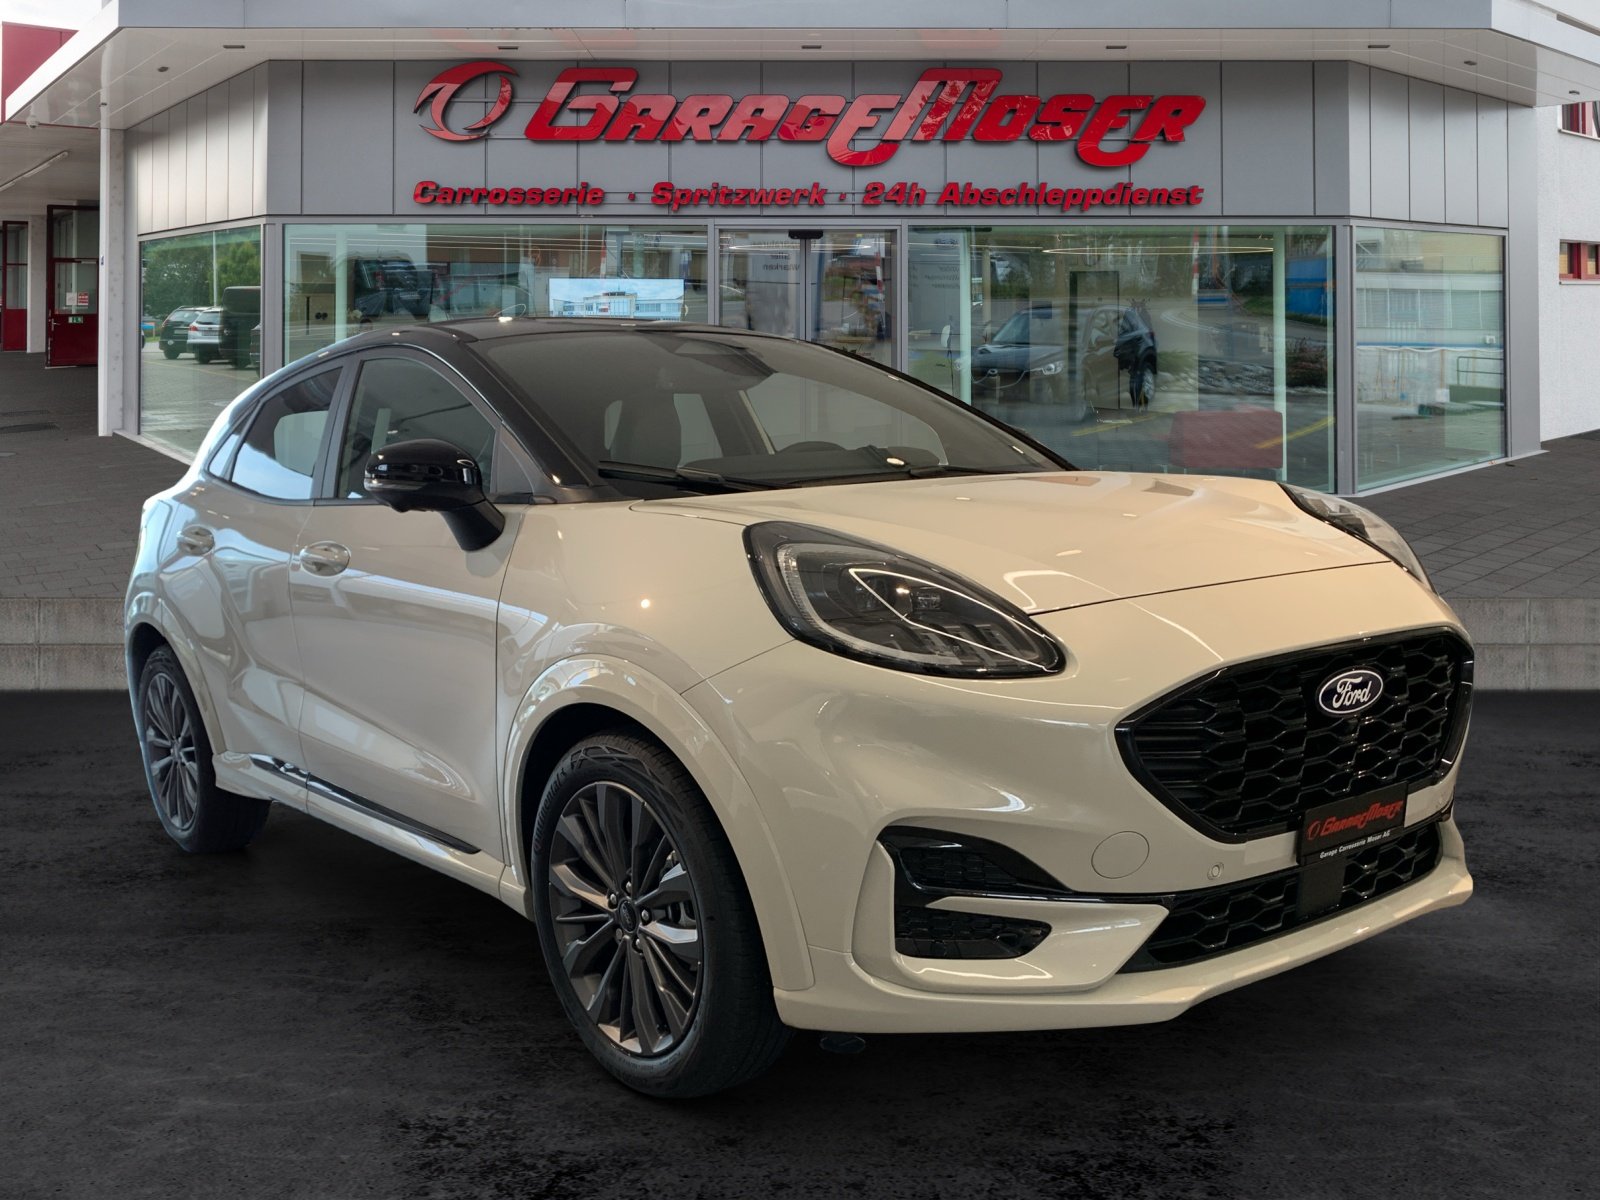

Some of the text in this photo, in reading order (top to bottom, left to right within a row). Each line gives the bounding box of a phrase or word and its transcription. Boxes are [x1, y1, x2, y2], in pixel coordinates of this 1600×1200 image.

[413, 181, 1204, 211] Carrosserie Spritzwerk 24h Abschleppdienst
[1332, 676, 1373, 709] Ford
[1319, 848, 1338, 859] Garage
[1366, 834, 1382, 843] Moser
[1382, 829, 1391, 837] AG
